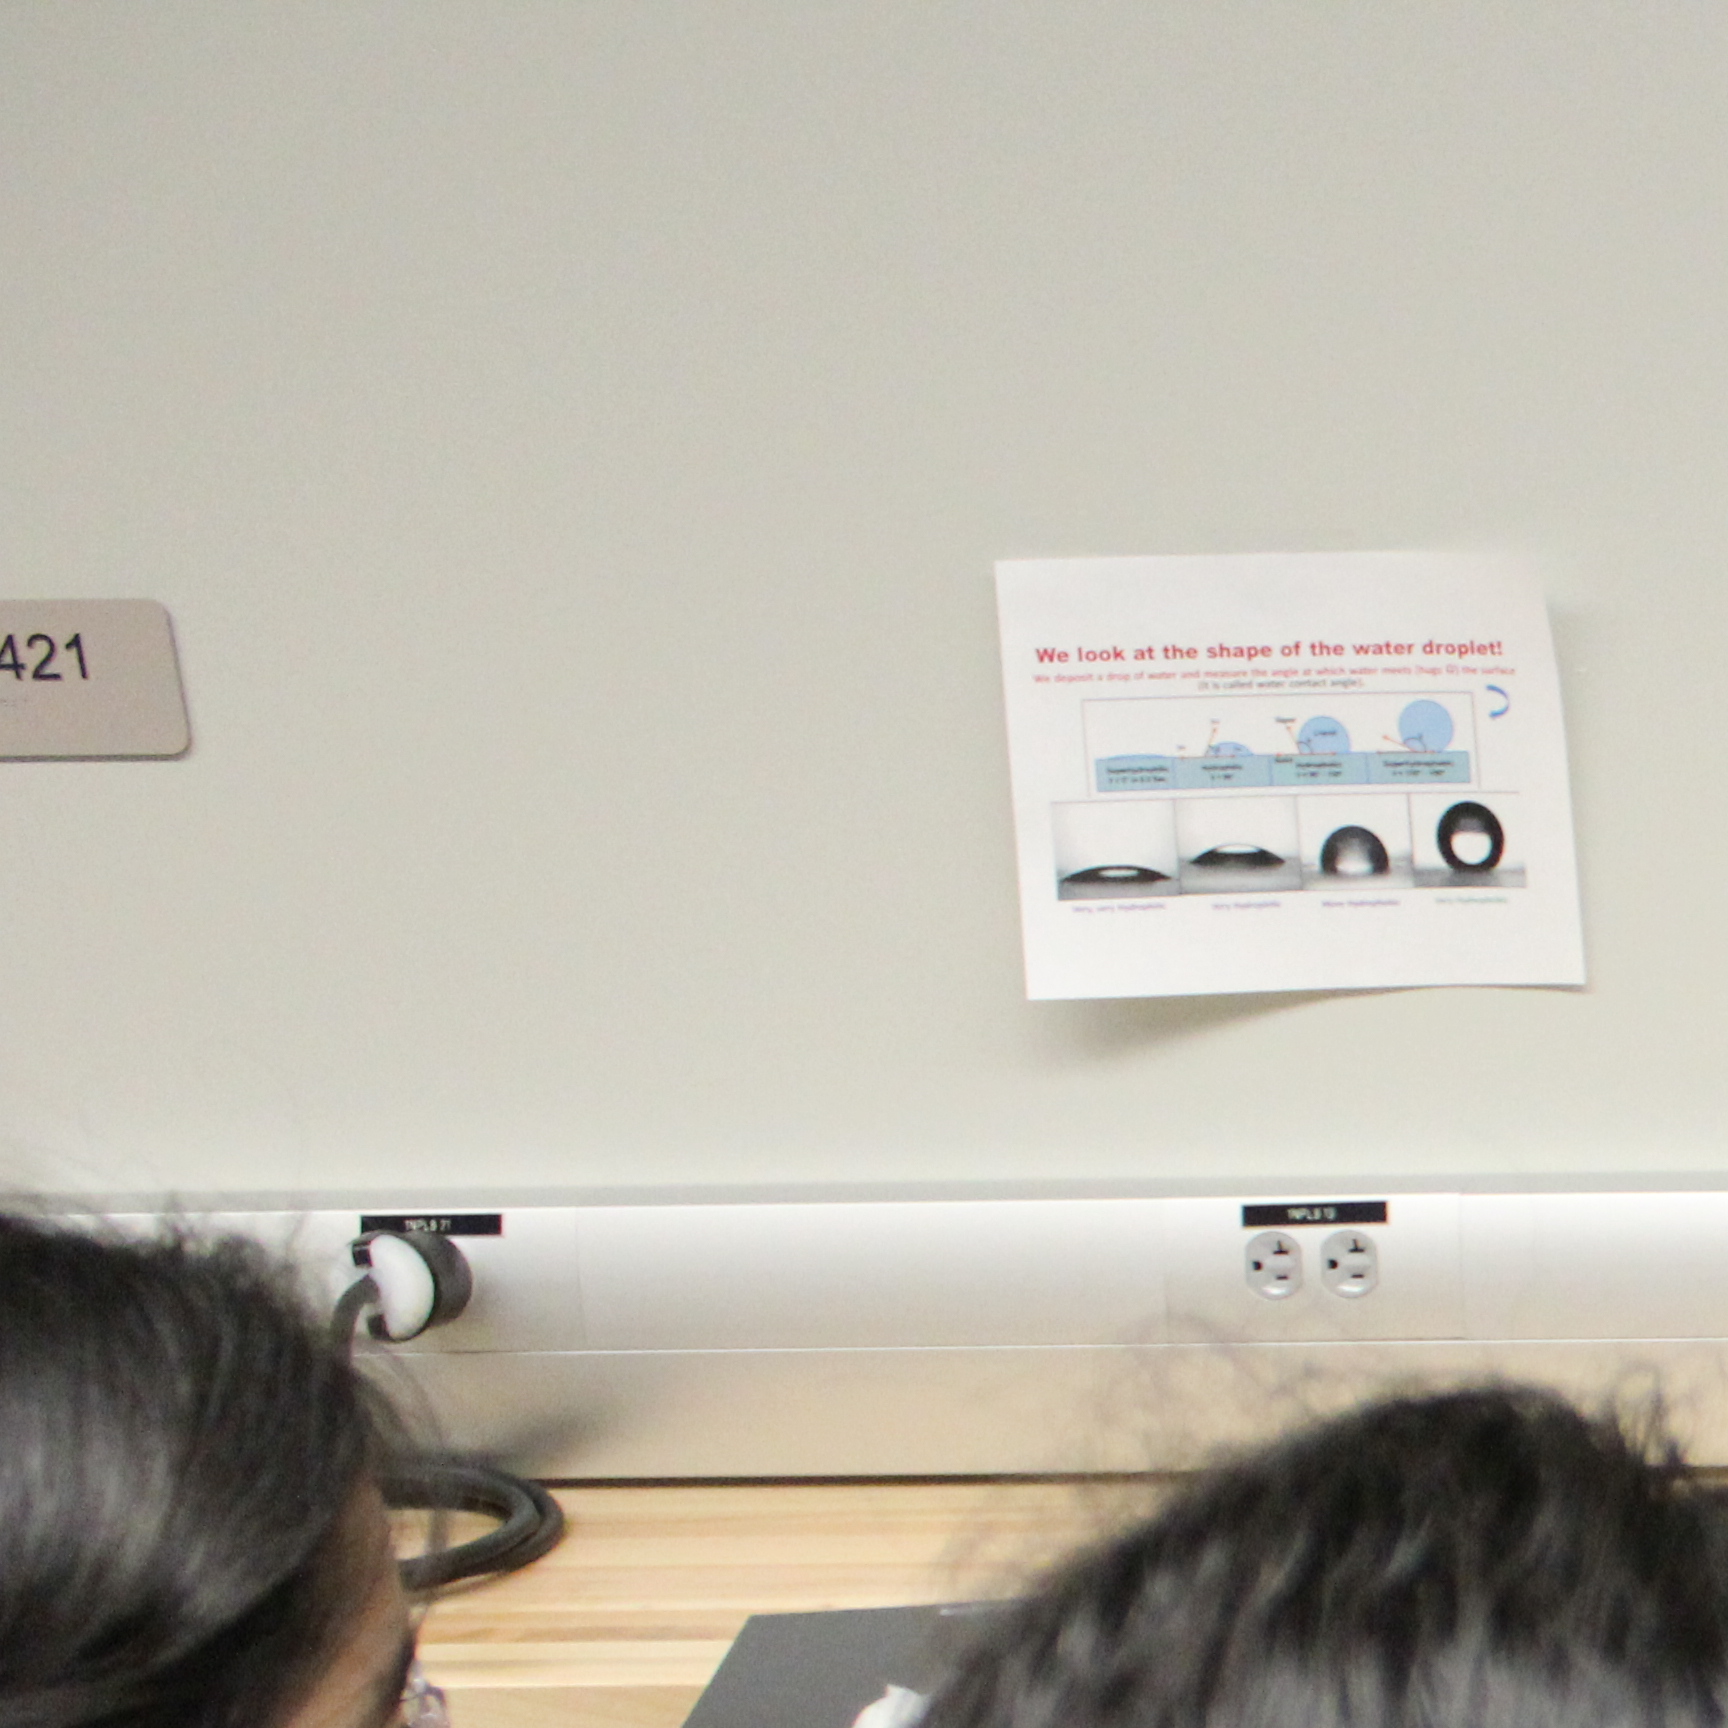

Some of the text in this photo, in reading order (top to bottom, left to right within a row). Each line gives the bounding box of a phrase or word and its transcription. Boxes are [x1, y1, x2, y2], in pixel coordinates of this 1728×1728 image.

[0, 633, 89, 681] 421
[1035, 640, 1504, 663] We look at the shape of the water droplet!
